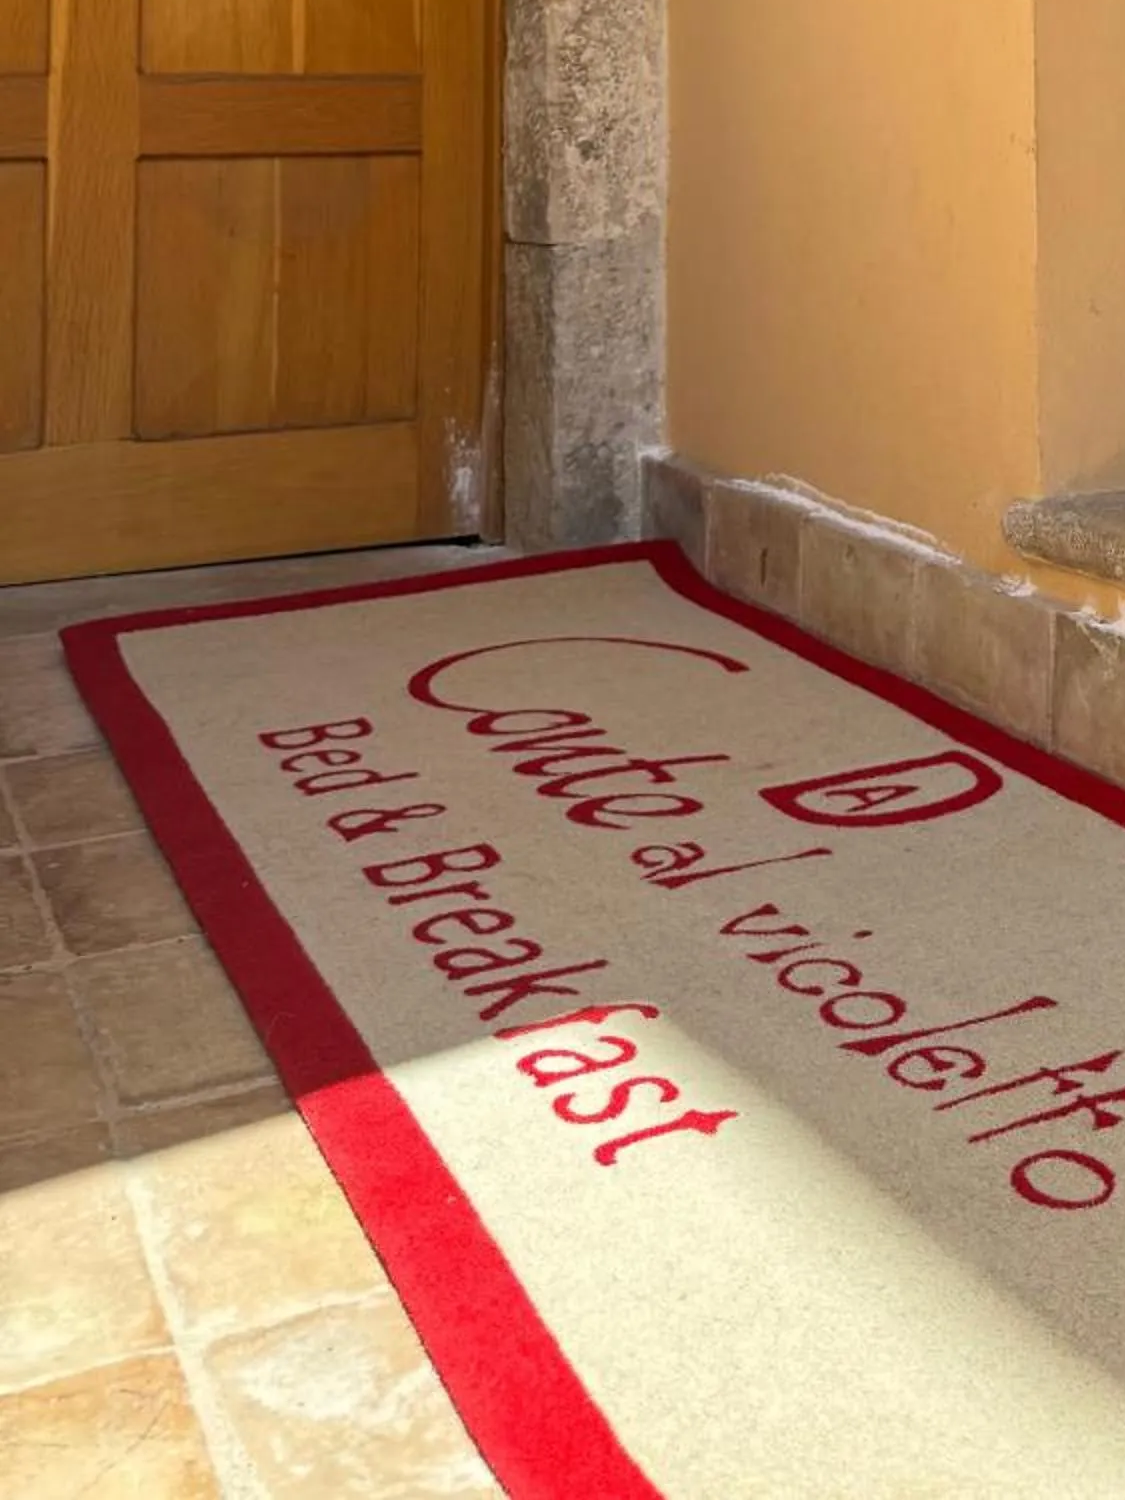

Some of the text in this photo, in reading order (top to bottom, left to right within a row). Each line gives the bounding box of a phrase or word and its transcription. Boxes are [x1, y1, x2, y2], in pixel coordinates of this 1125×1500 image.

[406, 636, 751, 830] Conte
[629, 841, 833, 890] al
[257, 716, 740, 1167] Bed & Breakfast
